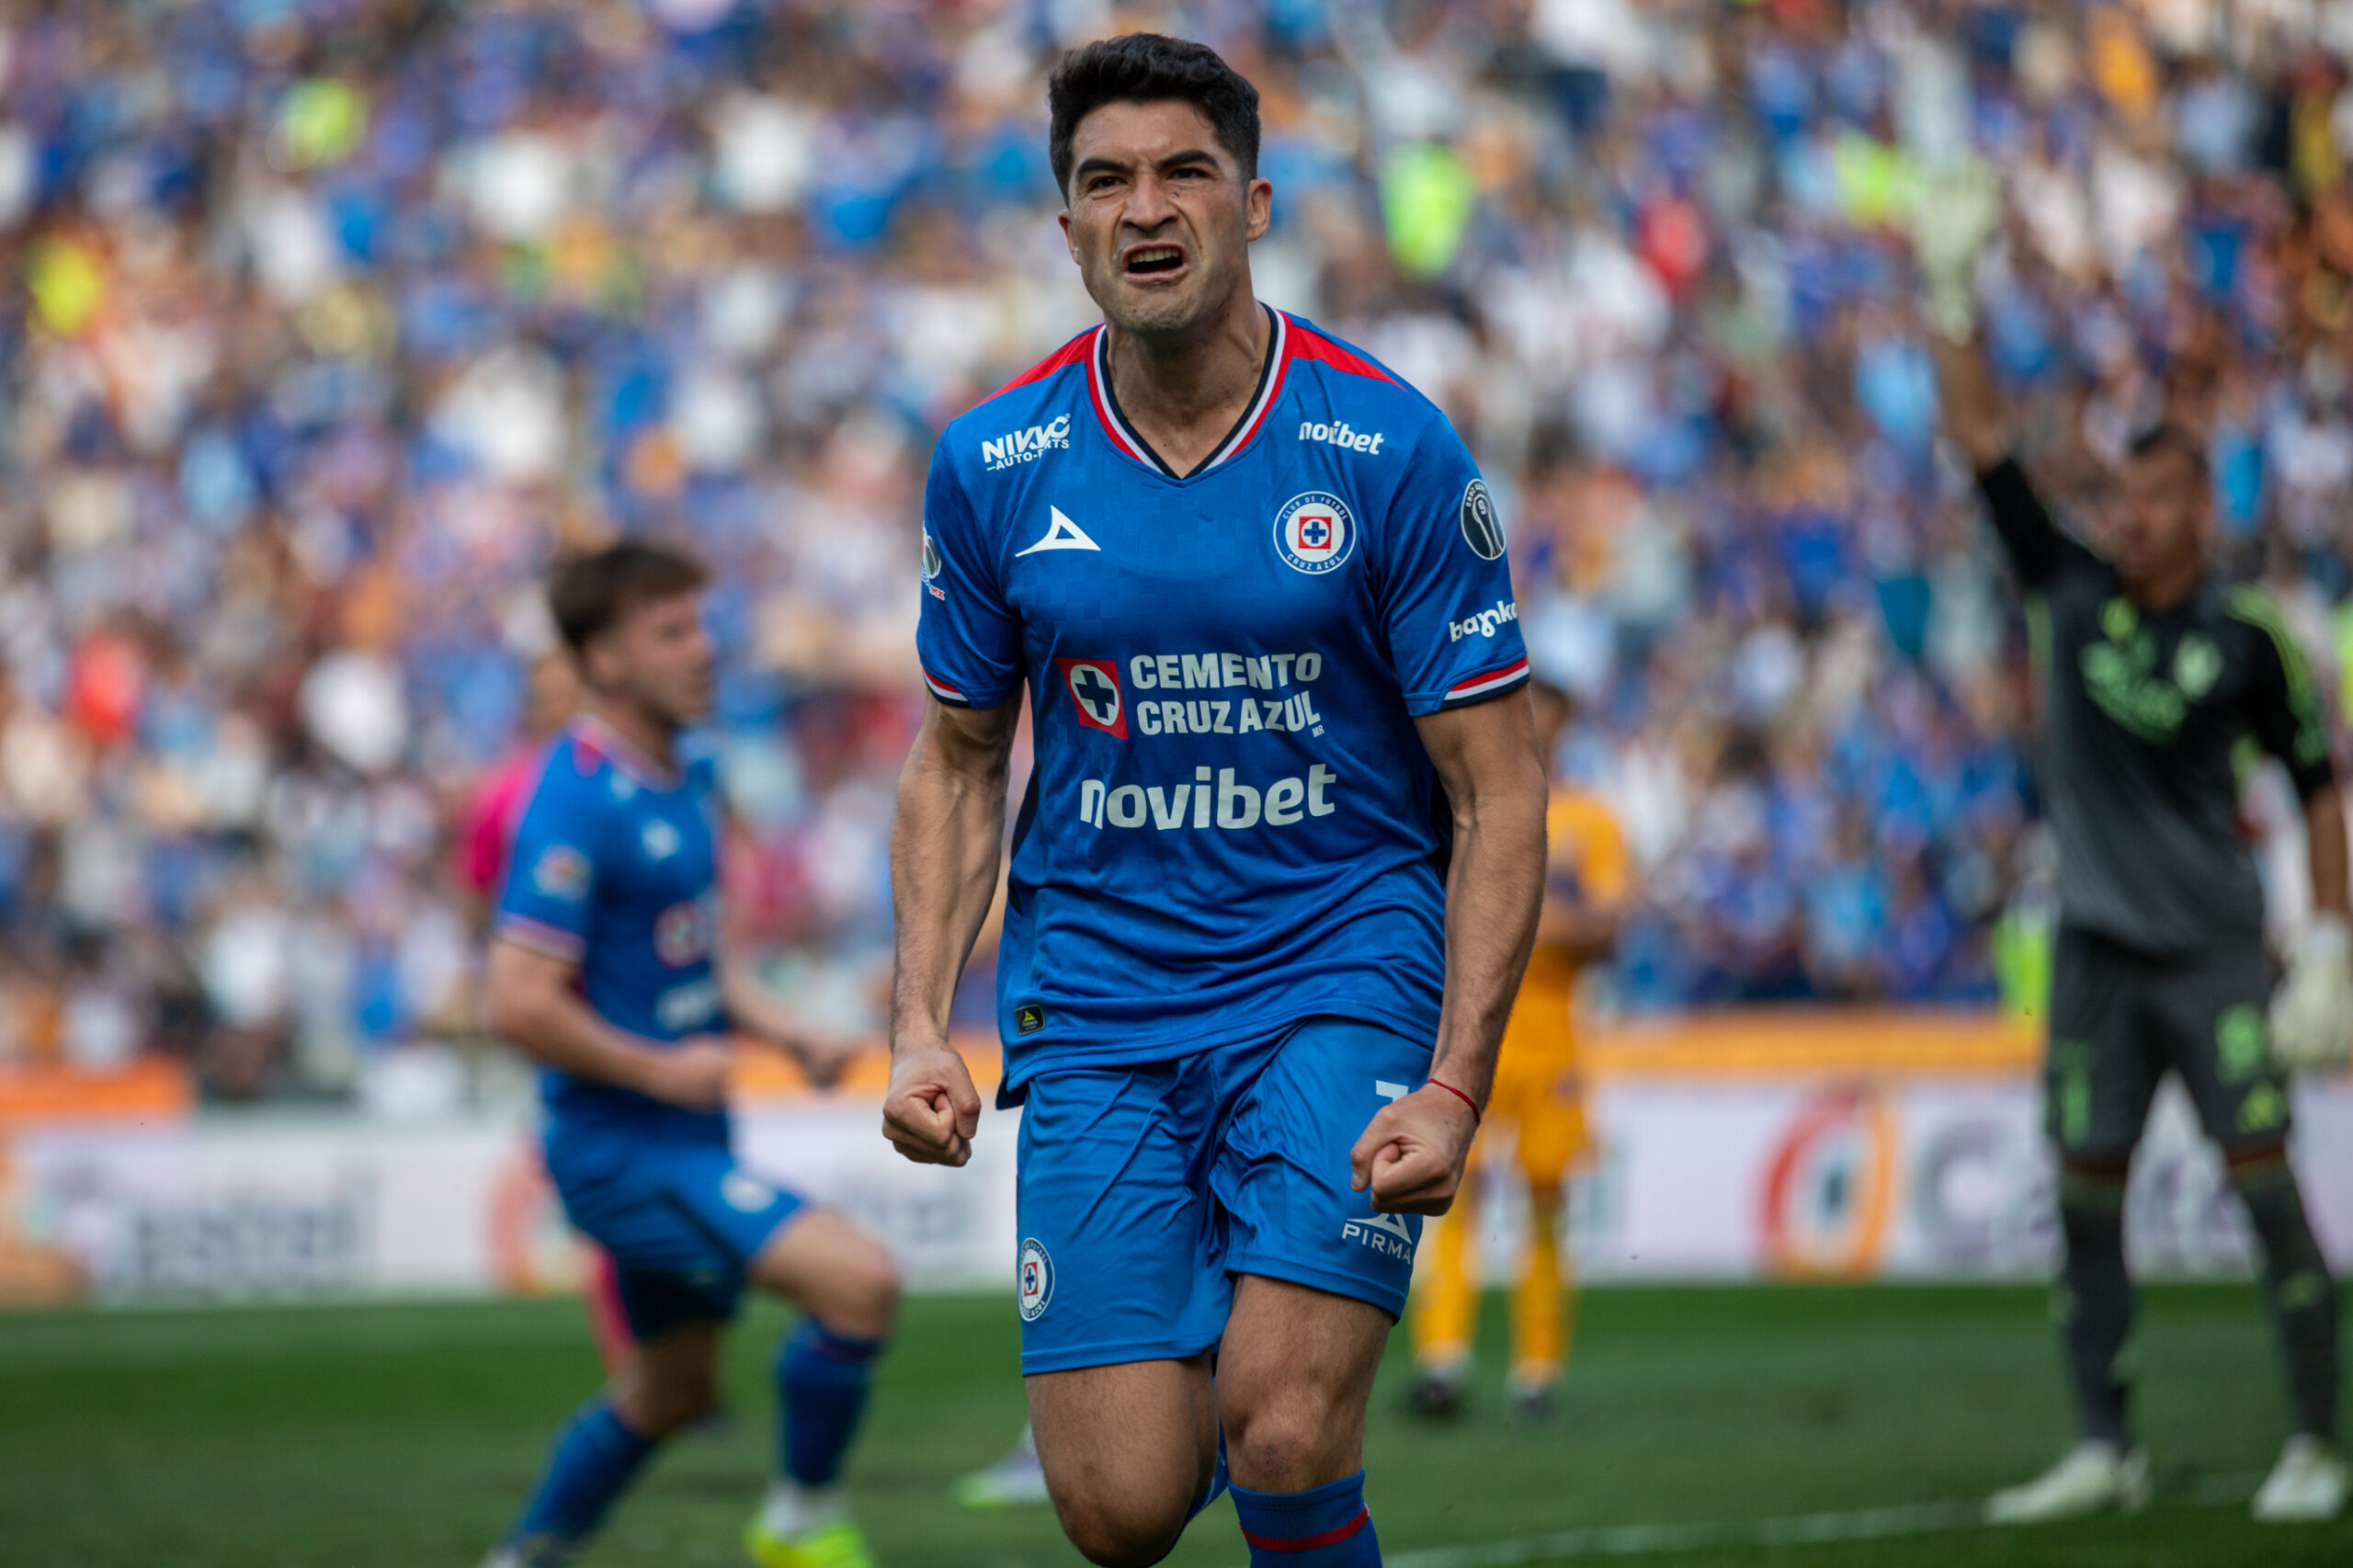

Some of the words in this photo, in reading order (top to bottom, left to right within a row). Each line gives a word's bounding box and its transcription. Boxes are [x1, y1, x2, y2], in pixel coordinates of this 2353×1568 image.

[995, 438, 1070, 471] AUTO-PRTS
[1282, 501, 1302, 520] CLUB
[1305, 495, 1316, 504] DE
[1320, 496, 1348, 521] FUTBOL
[1287, 553, 1313, 571] CRUZ
[1316, 555, 1342, 571] AZUL
[1130, 652, 1322, 689] CEMENTO
[1136, 700, 1233, 736] CRUZ
[1239, 690, 1321, 734] AZUL
[1312, 724, 1325, 738] MR
[1080, 763, 1336, 831] novibet
[1341, 1222, 1412, 1265] PIRMA
